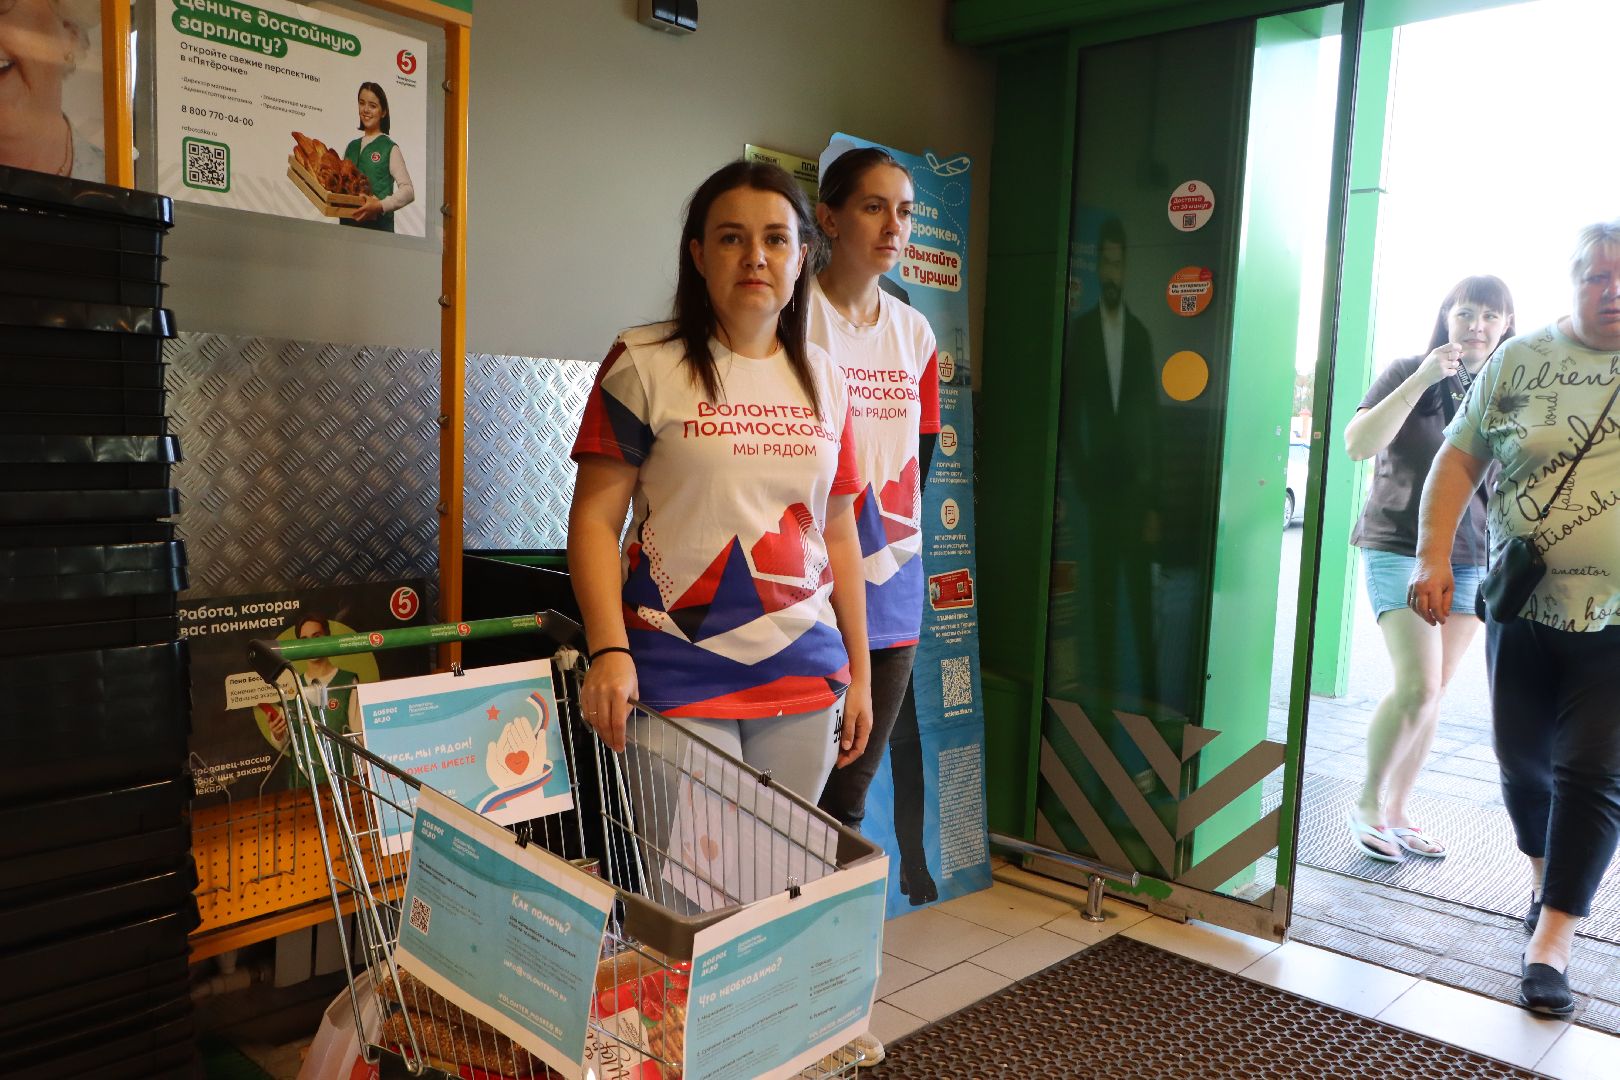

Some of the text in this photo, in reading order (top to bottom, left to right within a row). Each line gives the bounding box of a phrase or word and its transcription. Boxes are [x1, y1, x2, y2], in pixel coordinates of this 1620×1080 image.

[180, 16, 282, 54] зарплату?
[257, 11, 356, 52] достойную
[180, 42, 321, 83] Откройте свежие перспективы
[188, 56, 248, 76] «Пятёрочке»
[181, 104, 254, 127] 8 800 770-04-00
[902, 265, 959, 288] в Турции!
[866, 407, 907, 420] РЯДОМ
[733, 443, 817, 458] МЫ РЯДОМ
[1551, 565, 1610, 577] ancestor
[179, 600, 300, 621] Работа, которая
[180, 617, 285, 637] вас понимает
[415, 748, 432, 758] МЫ
[434, 736, 473, 755] РЯДОМ!
